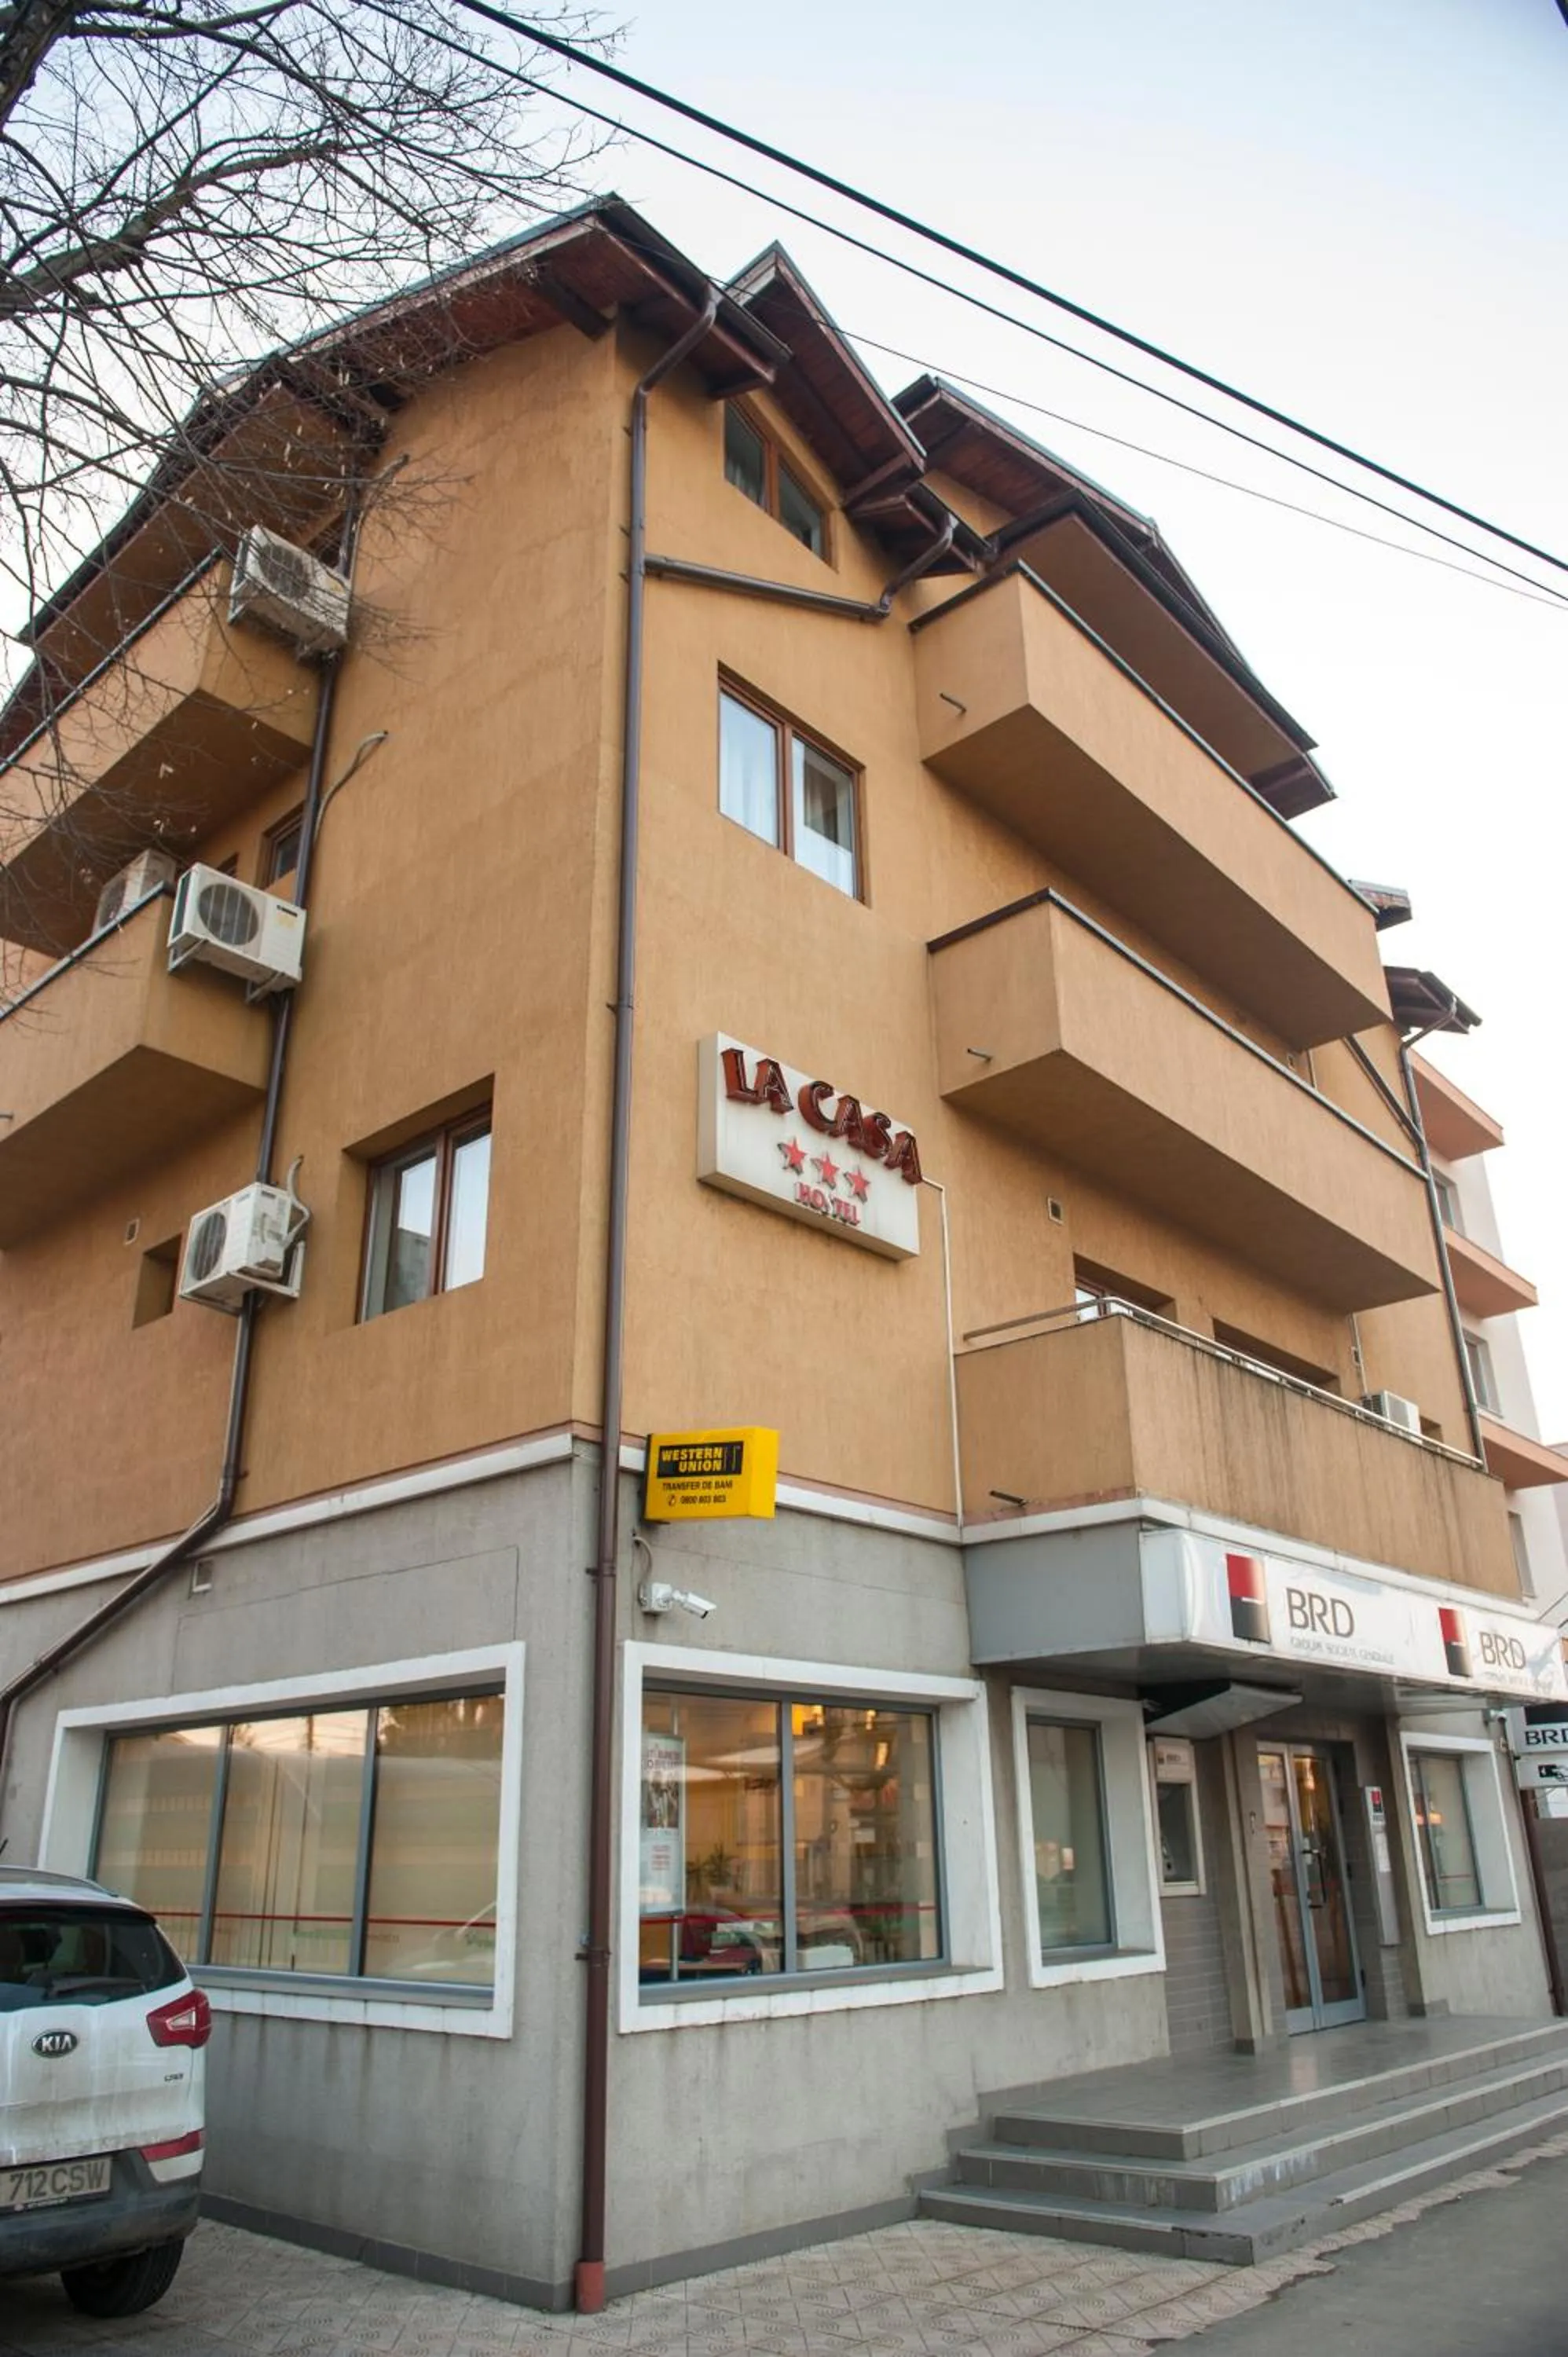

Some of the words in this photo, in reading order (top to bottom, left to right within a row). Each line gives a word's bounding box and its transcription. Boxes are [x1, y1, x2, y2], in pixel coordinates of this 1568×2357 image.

[720, 1047, 793, 1114] LA
[797, 1080, 922, 1184] CASA
[661, 1446, 723, 1461] WESTERN
[678, 1460, 722, 1473] UNION
[663, 1481, 701, 1490] TRANSFER
[702, 1480, 713, 1490] DE
[1286, 1587, 1355, 1639] BRD
[1479, 1631, 1526, 1670] BRD
[42, 2034, 72, 2051] KIA
